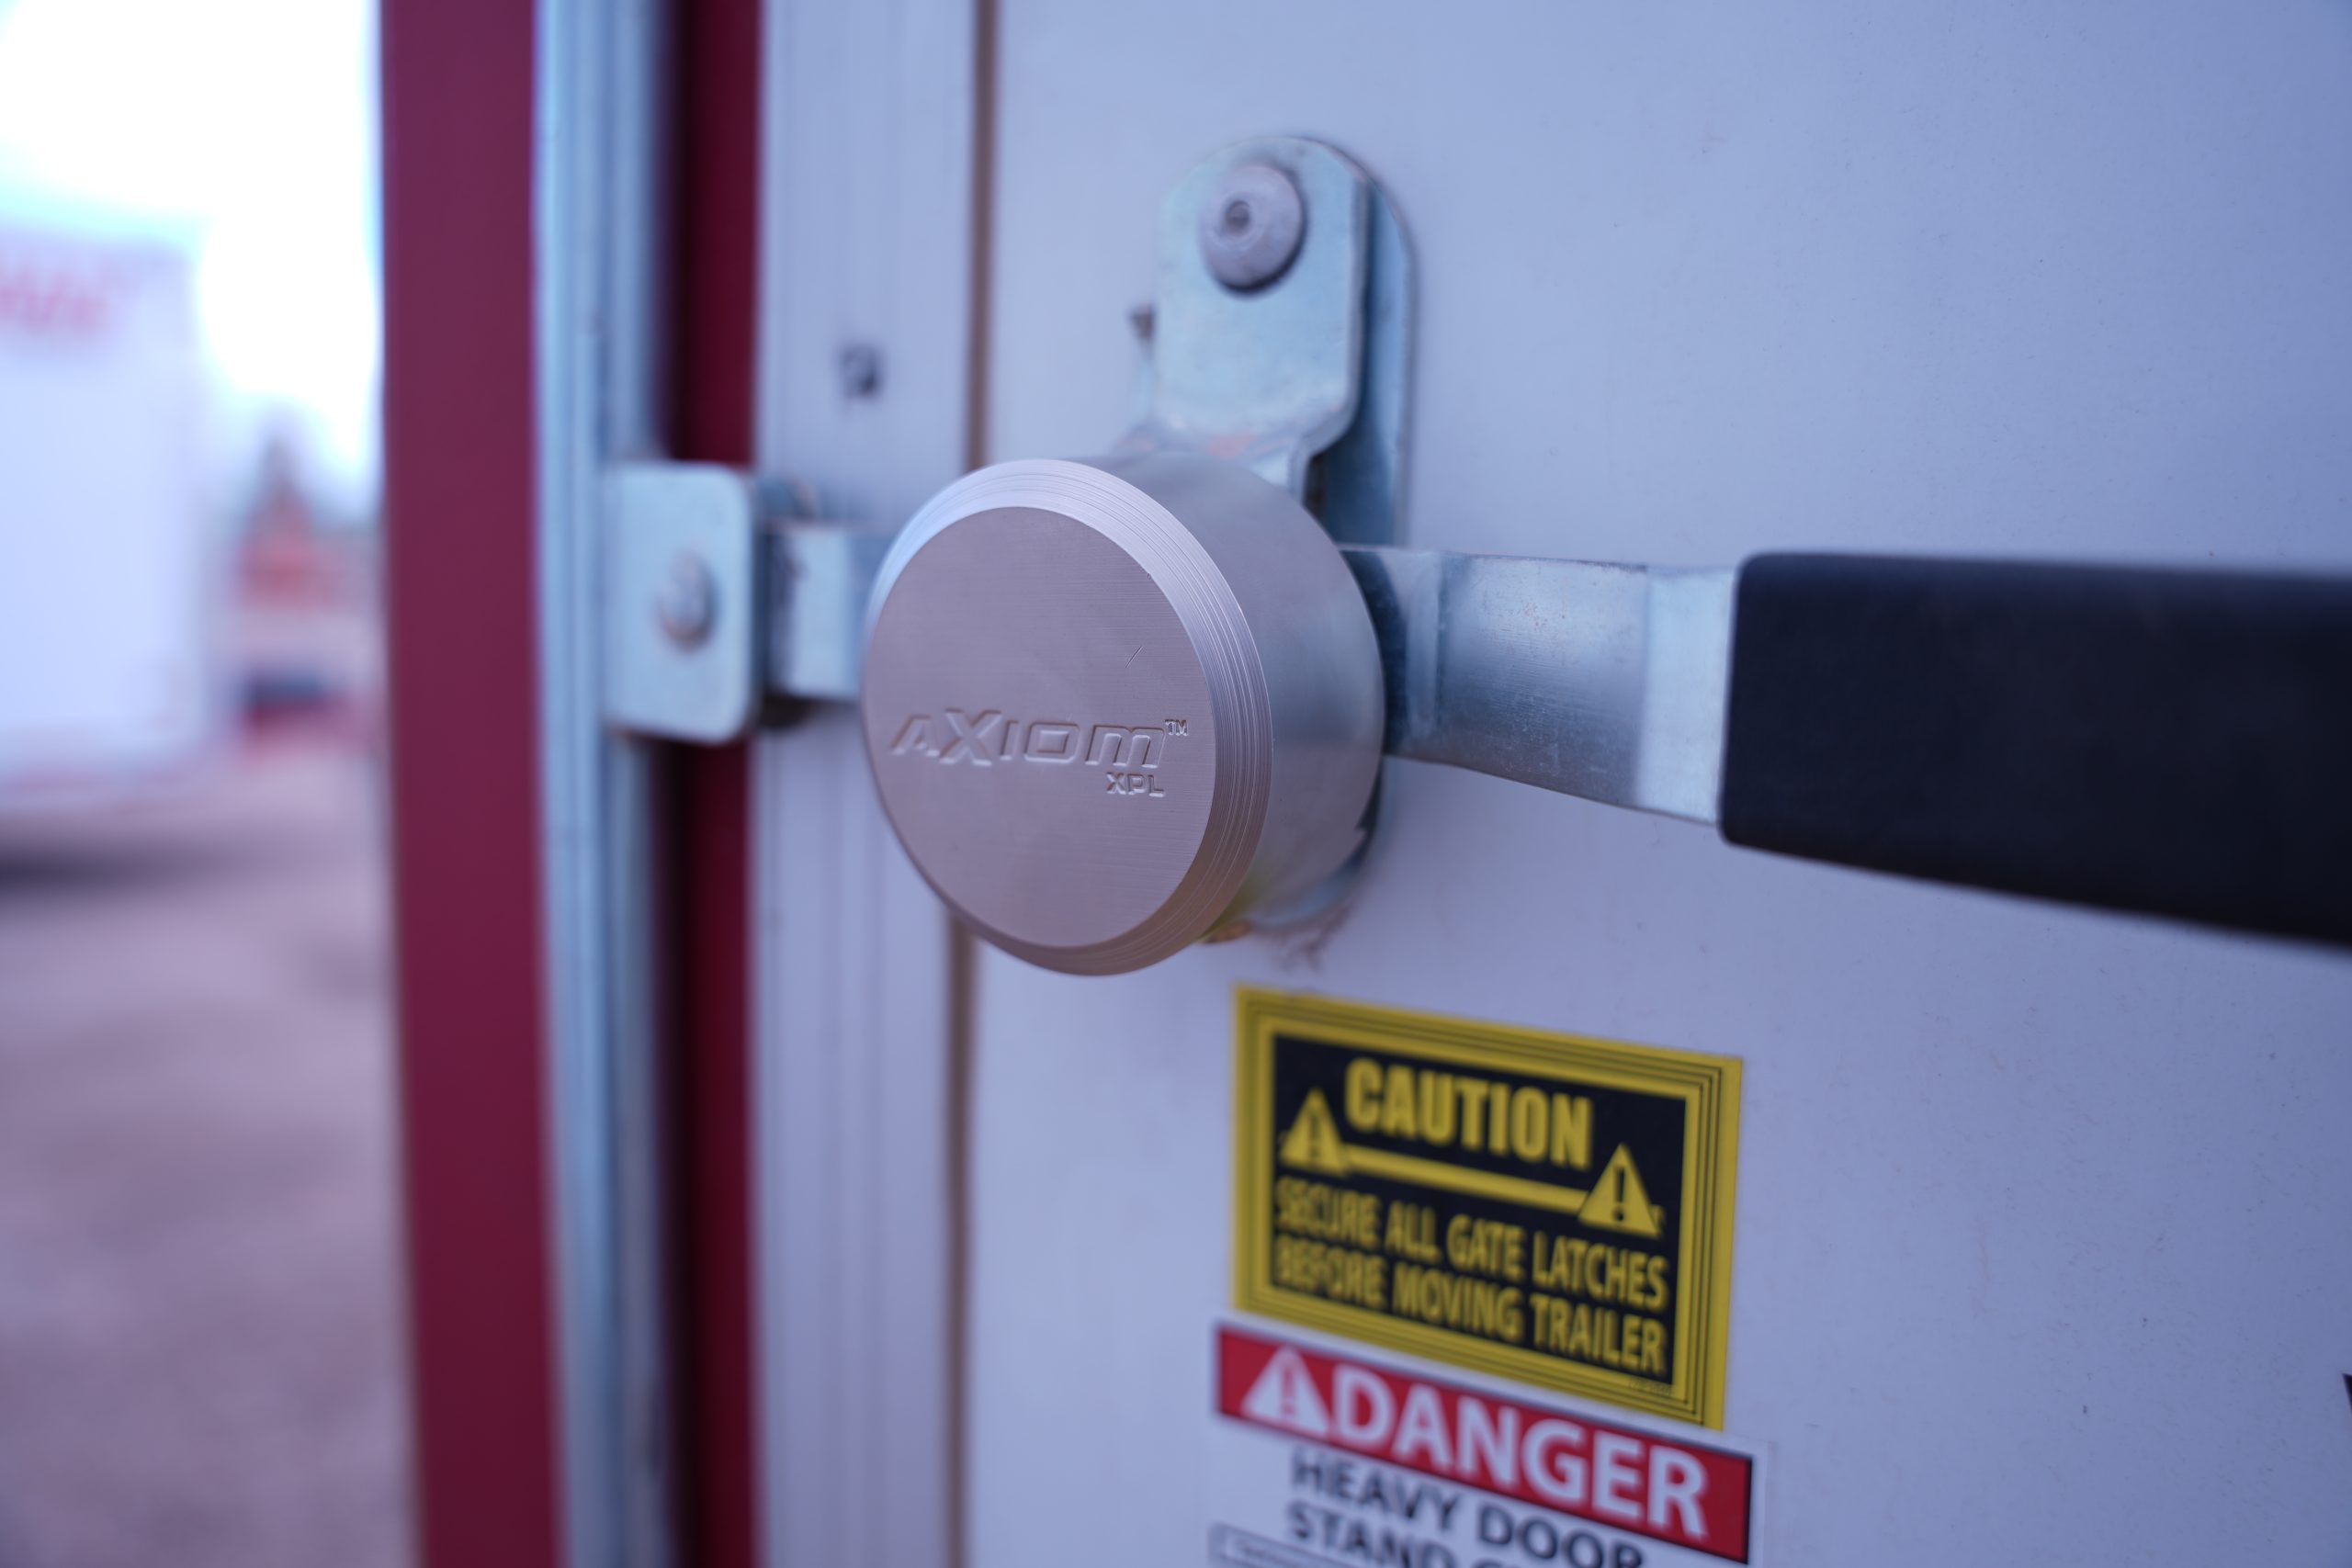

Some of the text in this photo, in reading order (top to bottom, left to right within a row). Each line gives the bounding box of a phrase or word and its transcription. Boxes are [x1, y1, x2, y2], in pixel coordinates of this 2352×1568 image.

[1106, 772, 1164, 797] XPL
[1344, 1057, 1592, 1171] CAUTION
[1276, 1234, 1668, 1376] BEFORE MOVING TRAILER
[1277, 1175, 1668, 1312] SECURE ALL GATE LATCHES
[1291, 1445, 1460, 1532] HEAVY
[1331, 1362, 1708, 1540] DANGER
